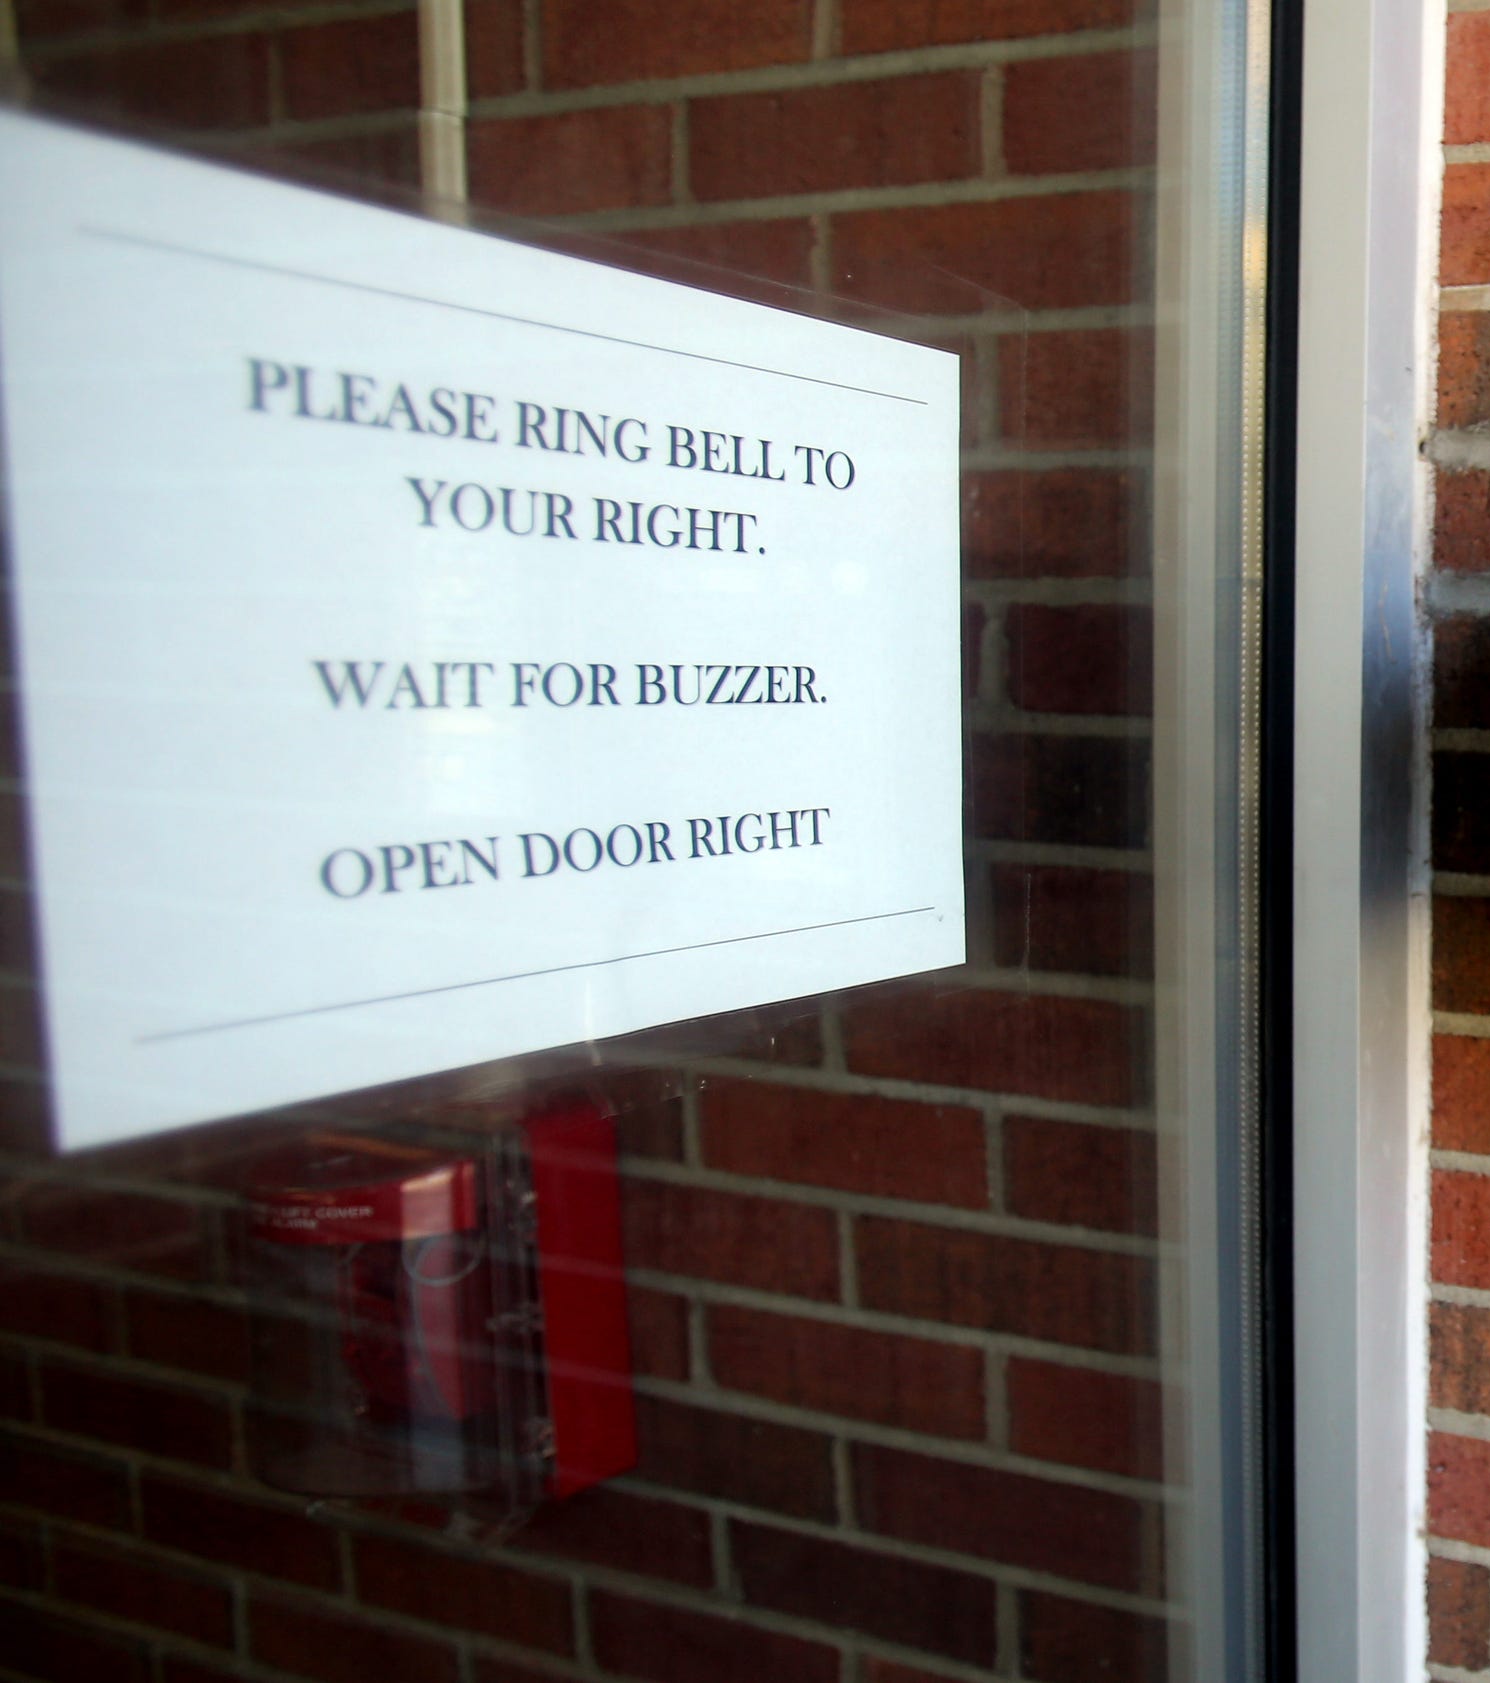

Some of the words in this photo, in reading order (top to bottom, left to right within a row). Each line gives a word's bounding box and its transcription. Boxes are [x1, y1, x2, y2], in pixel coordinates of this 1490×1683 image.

[247, 358, 498, 444] PLEASE
[515, 401, 650, 462] RING
[666, 426, 786, 482] BELL
[795, 445, 855, 490] TO
[406, 477, 578, 541] YOUR
[594, 499, 766, 554] RIGHT.
[312, 659, 494, 709] WAIT
[510, 662, 621, 707] FOR
[634, 663, 827, 705] BUZZER.
[320, 836, 500, 899] OPEN
[519, 823, 676, 880] DOOR
[688, 808, 830, 859] RIGHT
[314, 1205, 375, 1219] COVER
